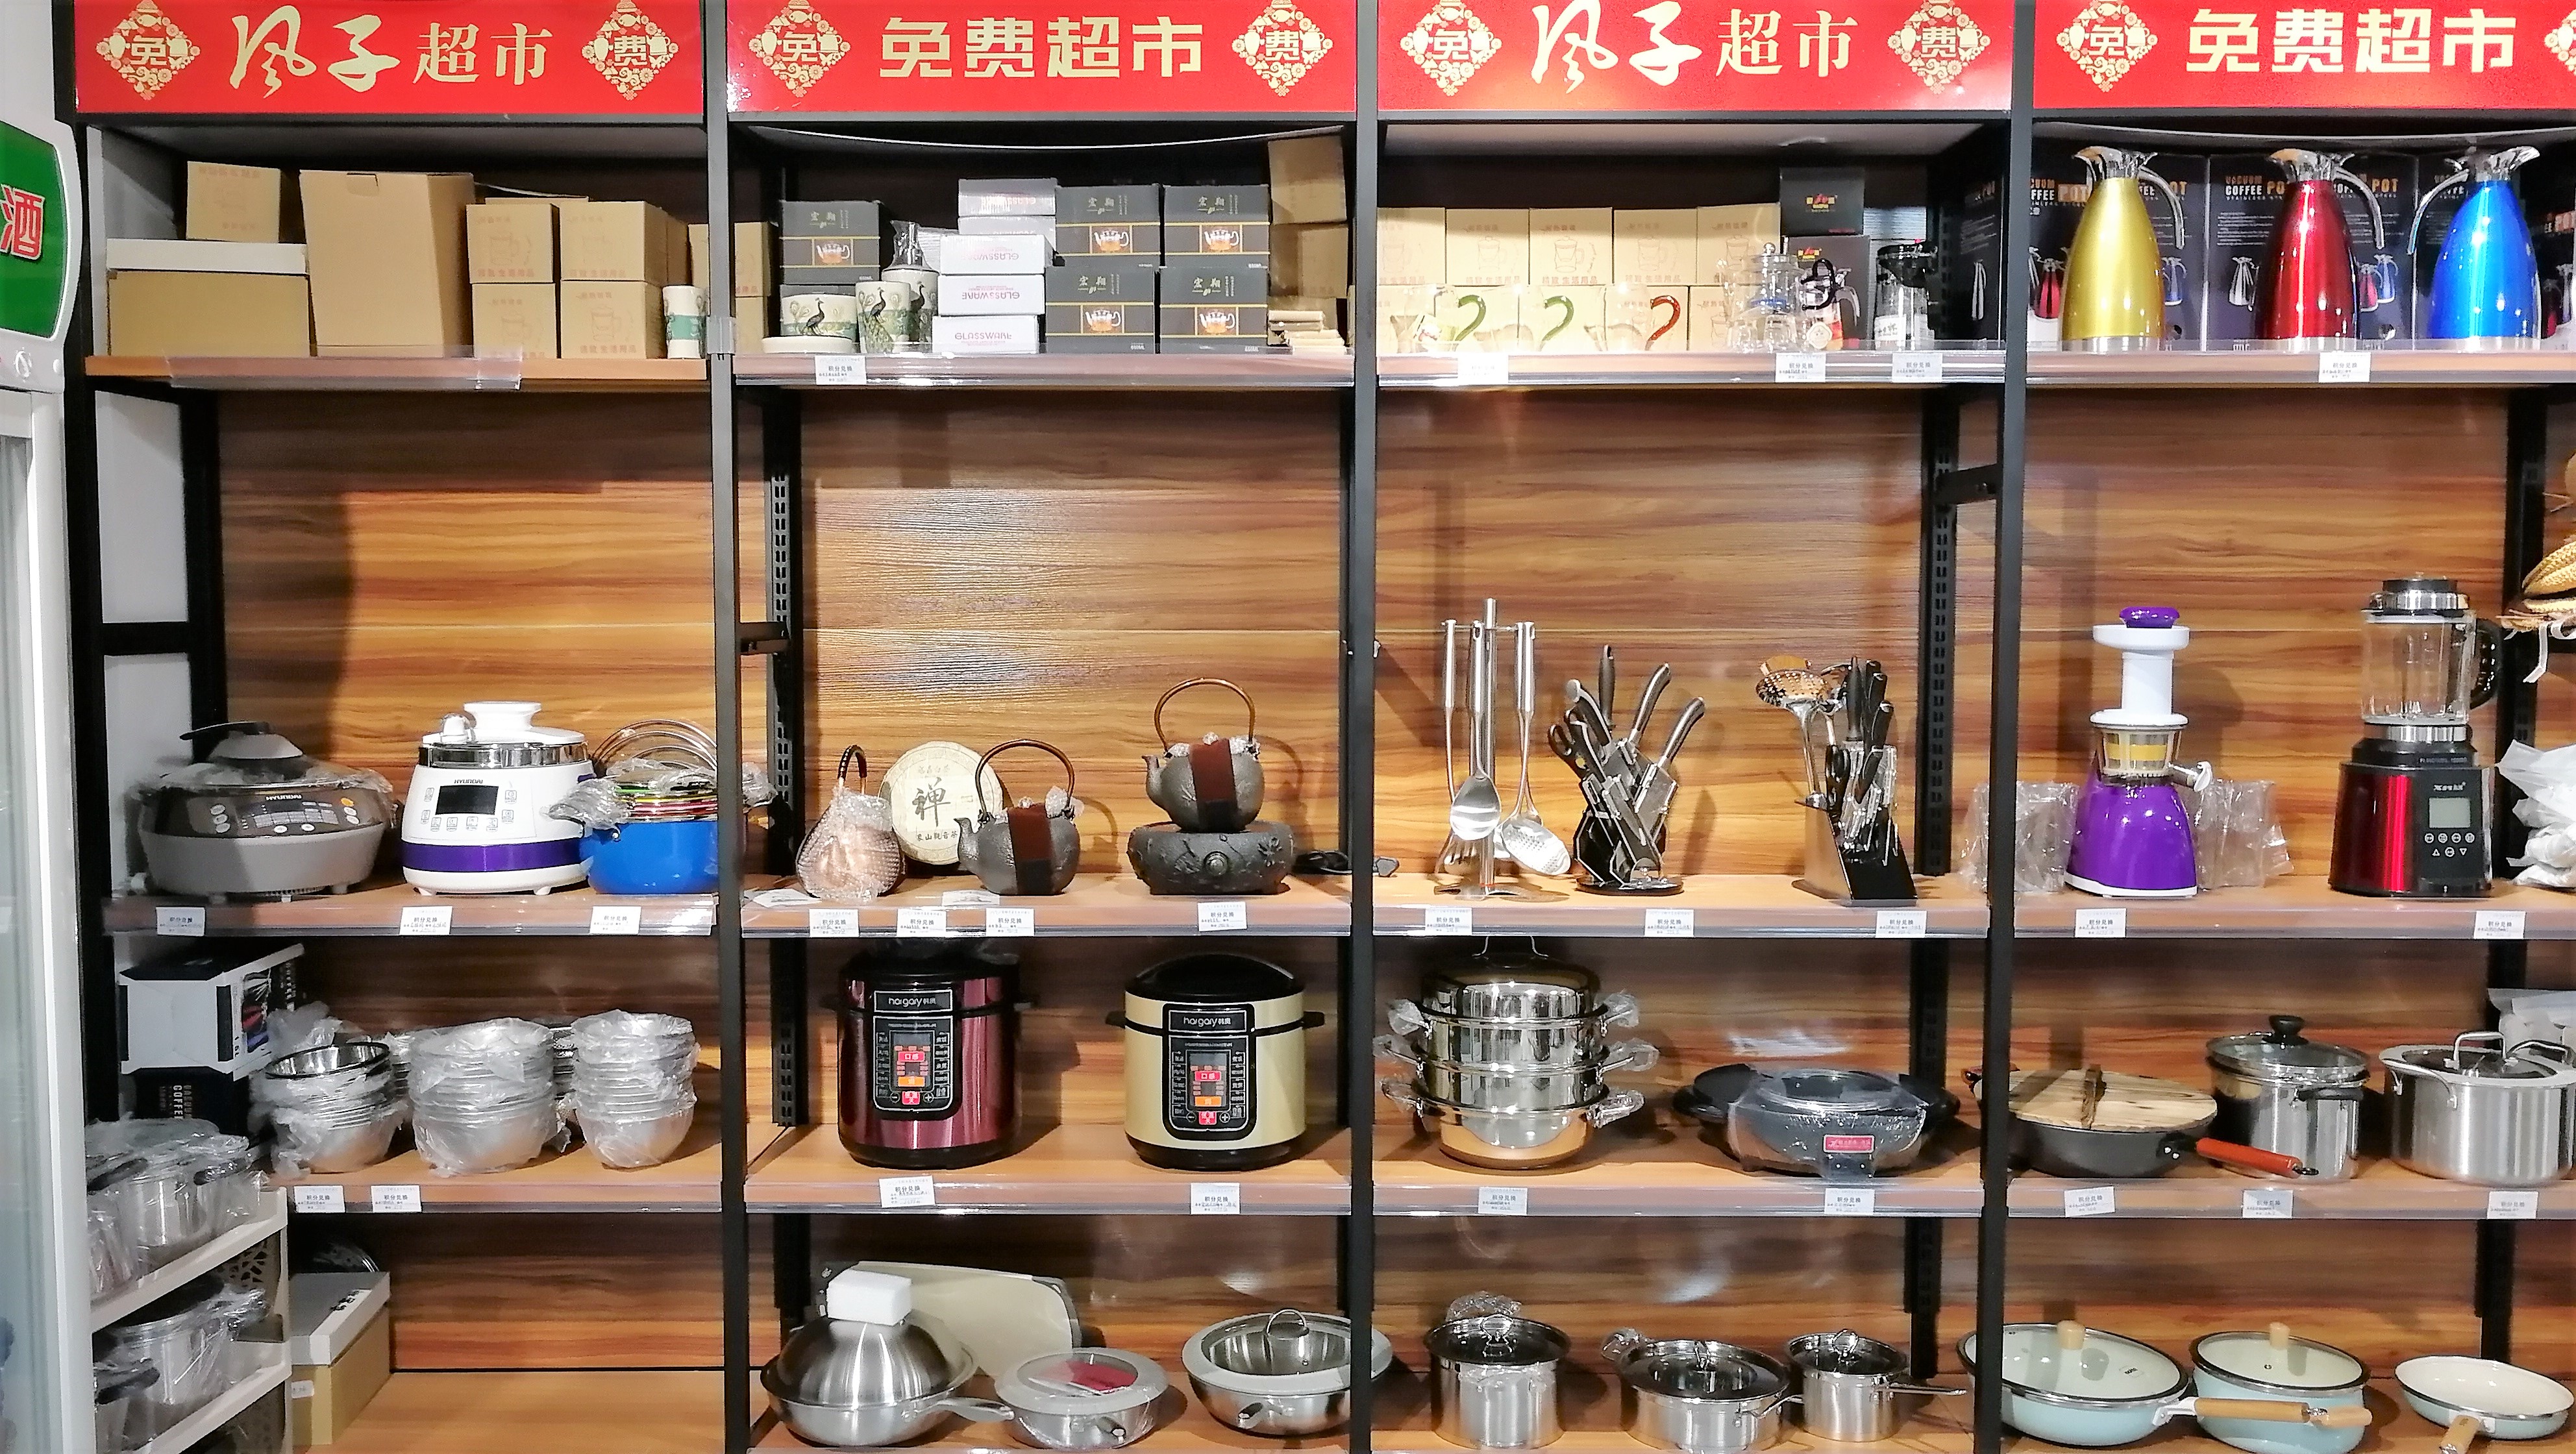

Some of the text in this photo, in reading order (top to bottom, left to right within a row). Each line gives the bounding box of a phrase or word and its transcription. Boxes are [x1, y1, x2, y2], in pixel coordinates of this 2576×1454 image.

[131, 36, 167, 66] 免
[613, 34, 647, 66] 费
[782, 32, 817, 62] 免
[880, 16, 1203, 78] 免费超市
[1265, 30, 1300, 60] 费
[1433, 29, 1470, 58] 免
[1920, 26, 1957, 57] 费
[2089, 25, 2125, 56] 免
[2186, 8, 2517, 73] 免费超市
[2225, 181, 2285, 195] COFFEE PO
[2372, 179, 2399, 193] POT
[0, 184, 44, 259] 酒
[173, 1085, 183, 1119] COFFE
